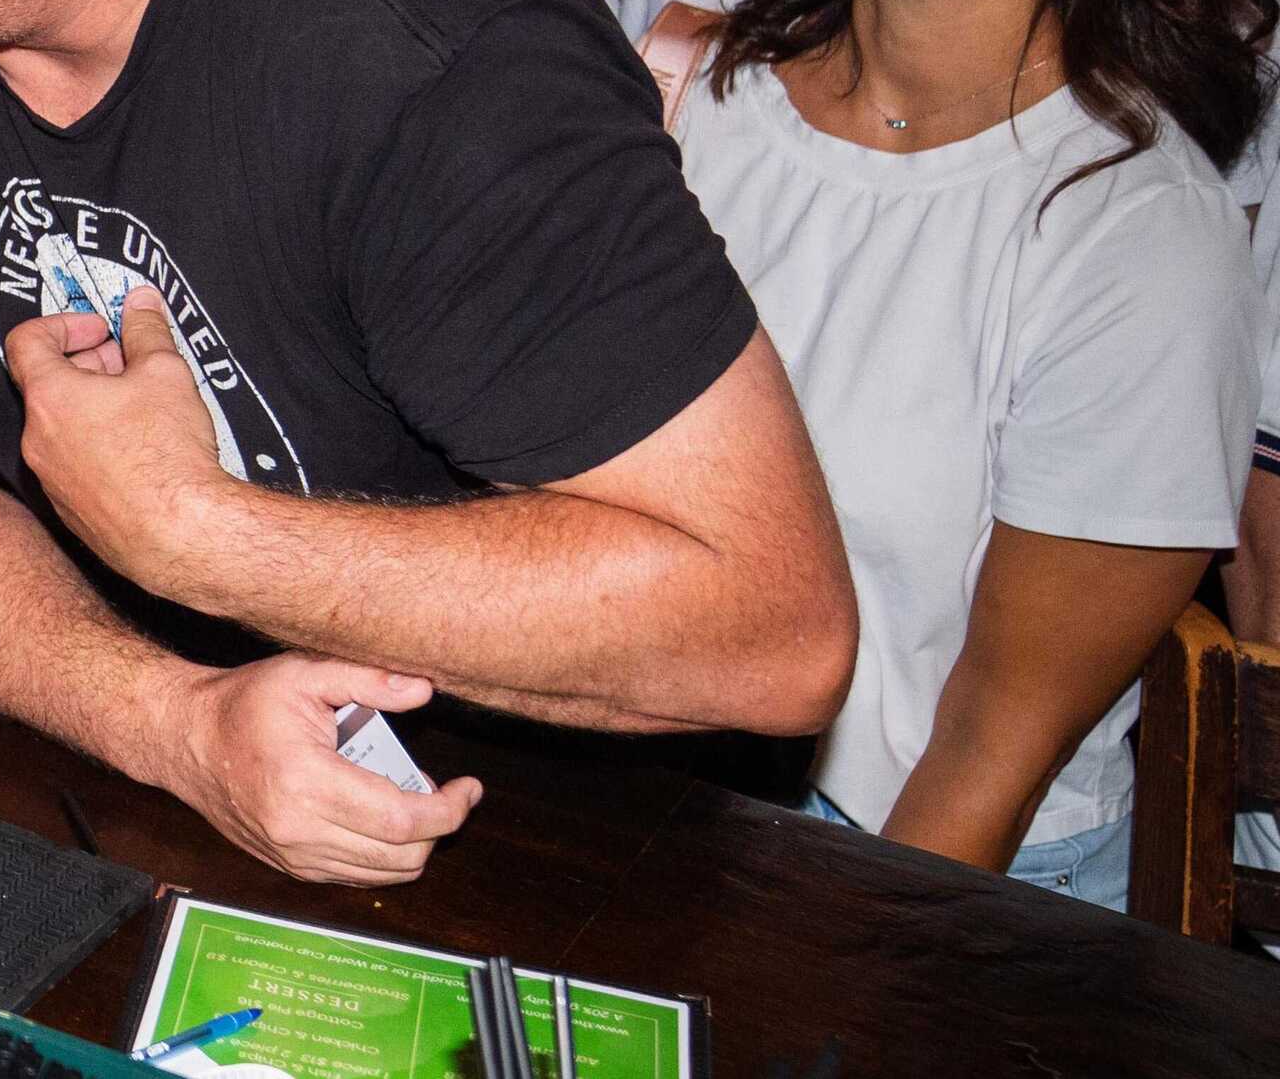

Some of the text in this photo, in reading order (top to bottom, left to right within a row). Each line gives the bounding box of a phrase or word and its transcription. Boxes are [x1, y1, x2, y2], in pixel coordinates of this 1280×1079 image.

[122, 223, 239, 392] UNITED
[234, 934, 294, 954] matches
[296, 946, 326, 961] Cup
[232, 956, 287, 975] Cream
[328, 951, 369, 968] World
[371, 961, 388, 972] all
[392, 967, 410, 979] for
[412, 971, 469, 990] ncluded
[247, 978, 361, 1012] DESSERT
[308, 972, 410, 1001] Strawberries
[250, 1021, 292, 1036] Chip
[296, 1010, 364, 1030] Cottage
[311, 1032, 381, 1056] Chicken
